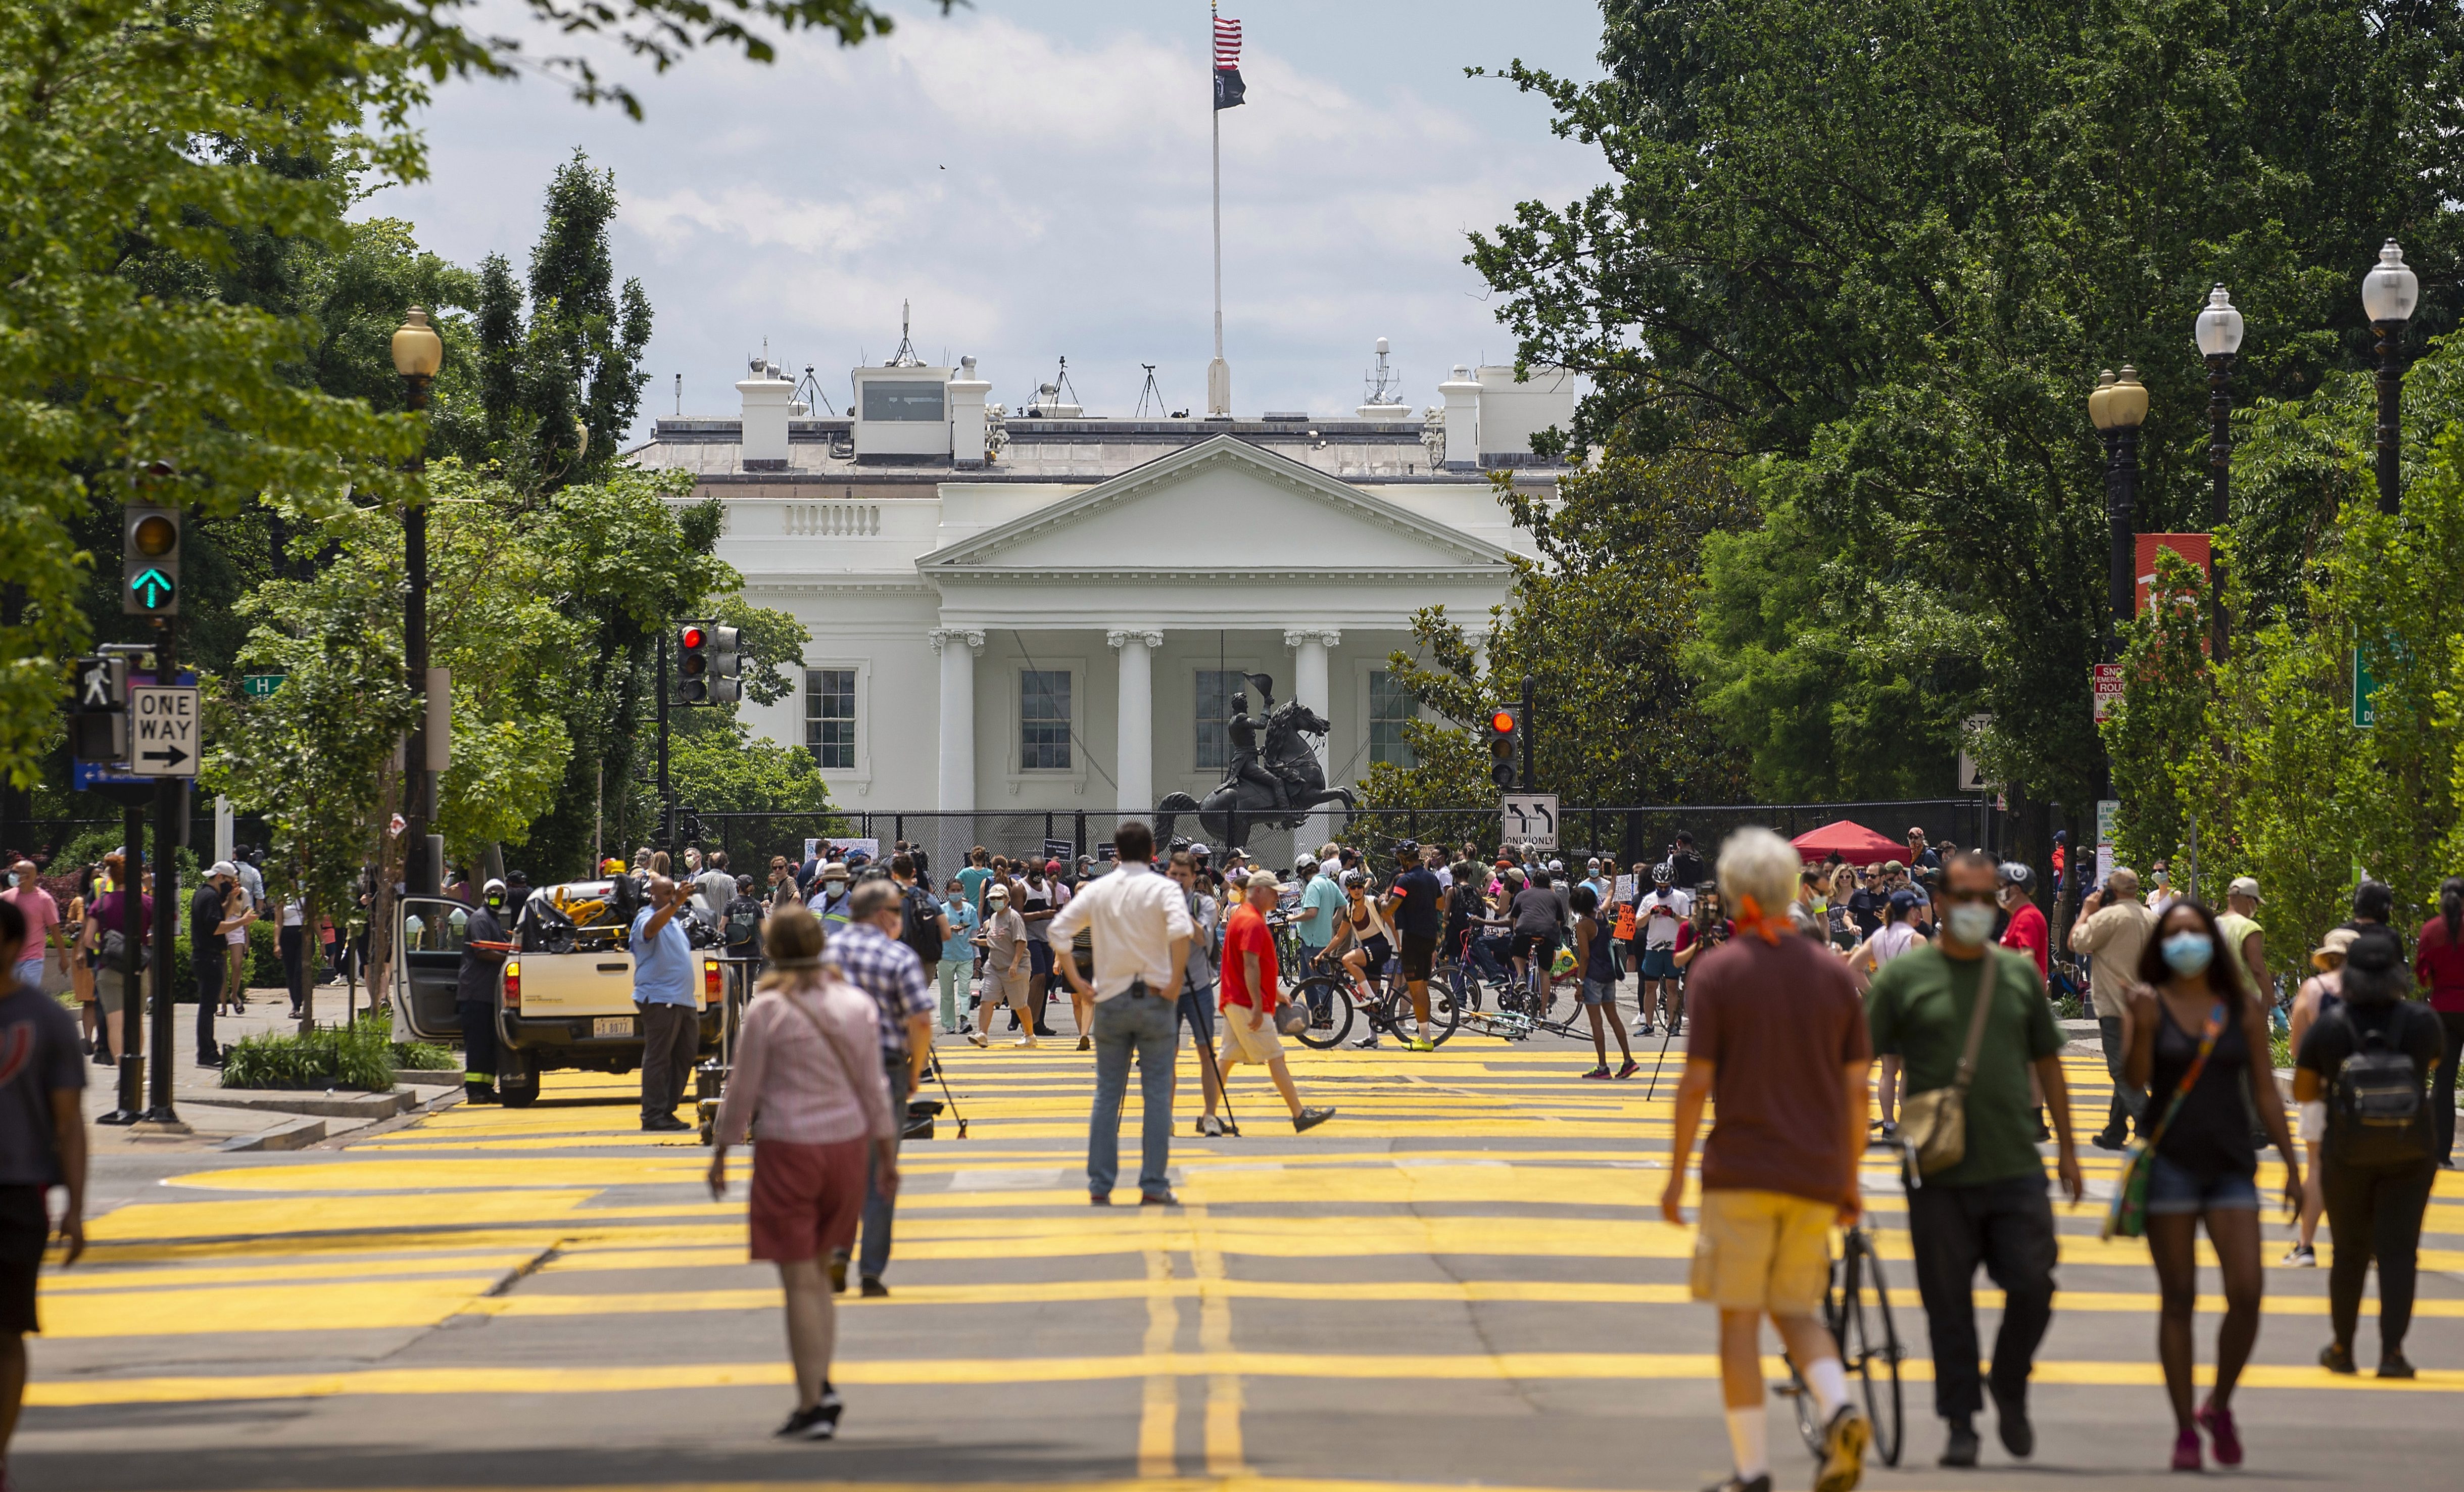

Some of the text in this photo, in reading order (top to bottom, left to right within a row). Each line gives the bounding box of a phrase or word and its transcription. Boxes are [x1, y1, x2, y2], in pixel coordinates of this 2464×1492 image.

[2103, 667, 2122, 676] SNO
[257, 679, 268, 692] H
[141, 695, 189, 715] ONE
[140, 720, 191, 740] WAY
[1532, 837, 1554, 845] ONLY
[1621, 905, 1634, 914] JUS
[1619, 915, 1635, 923] #Bre
